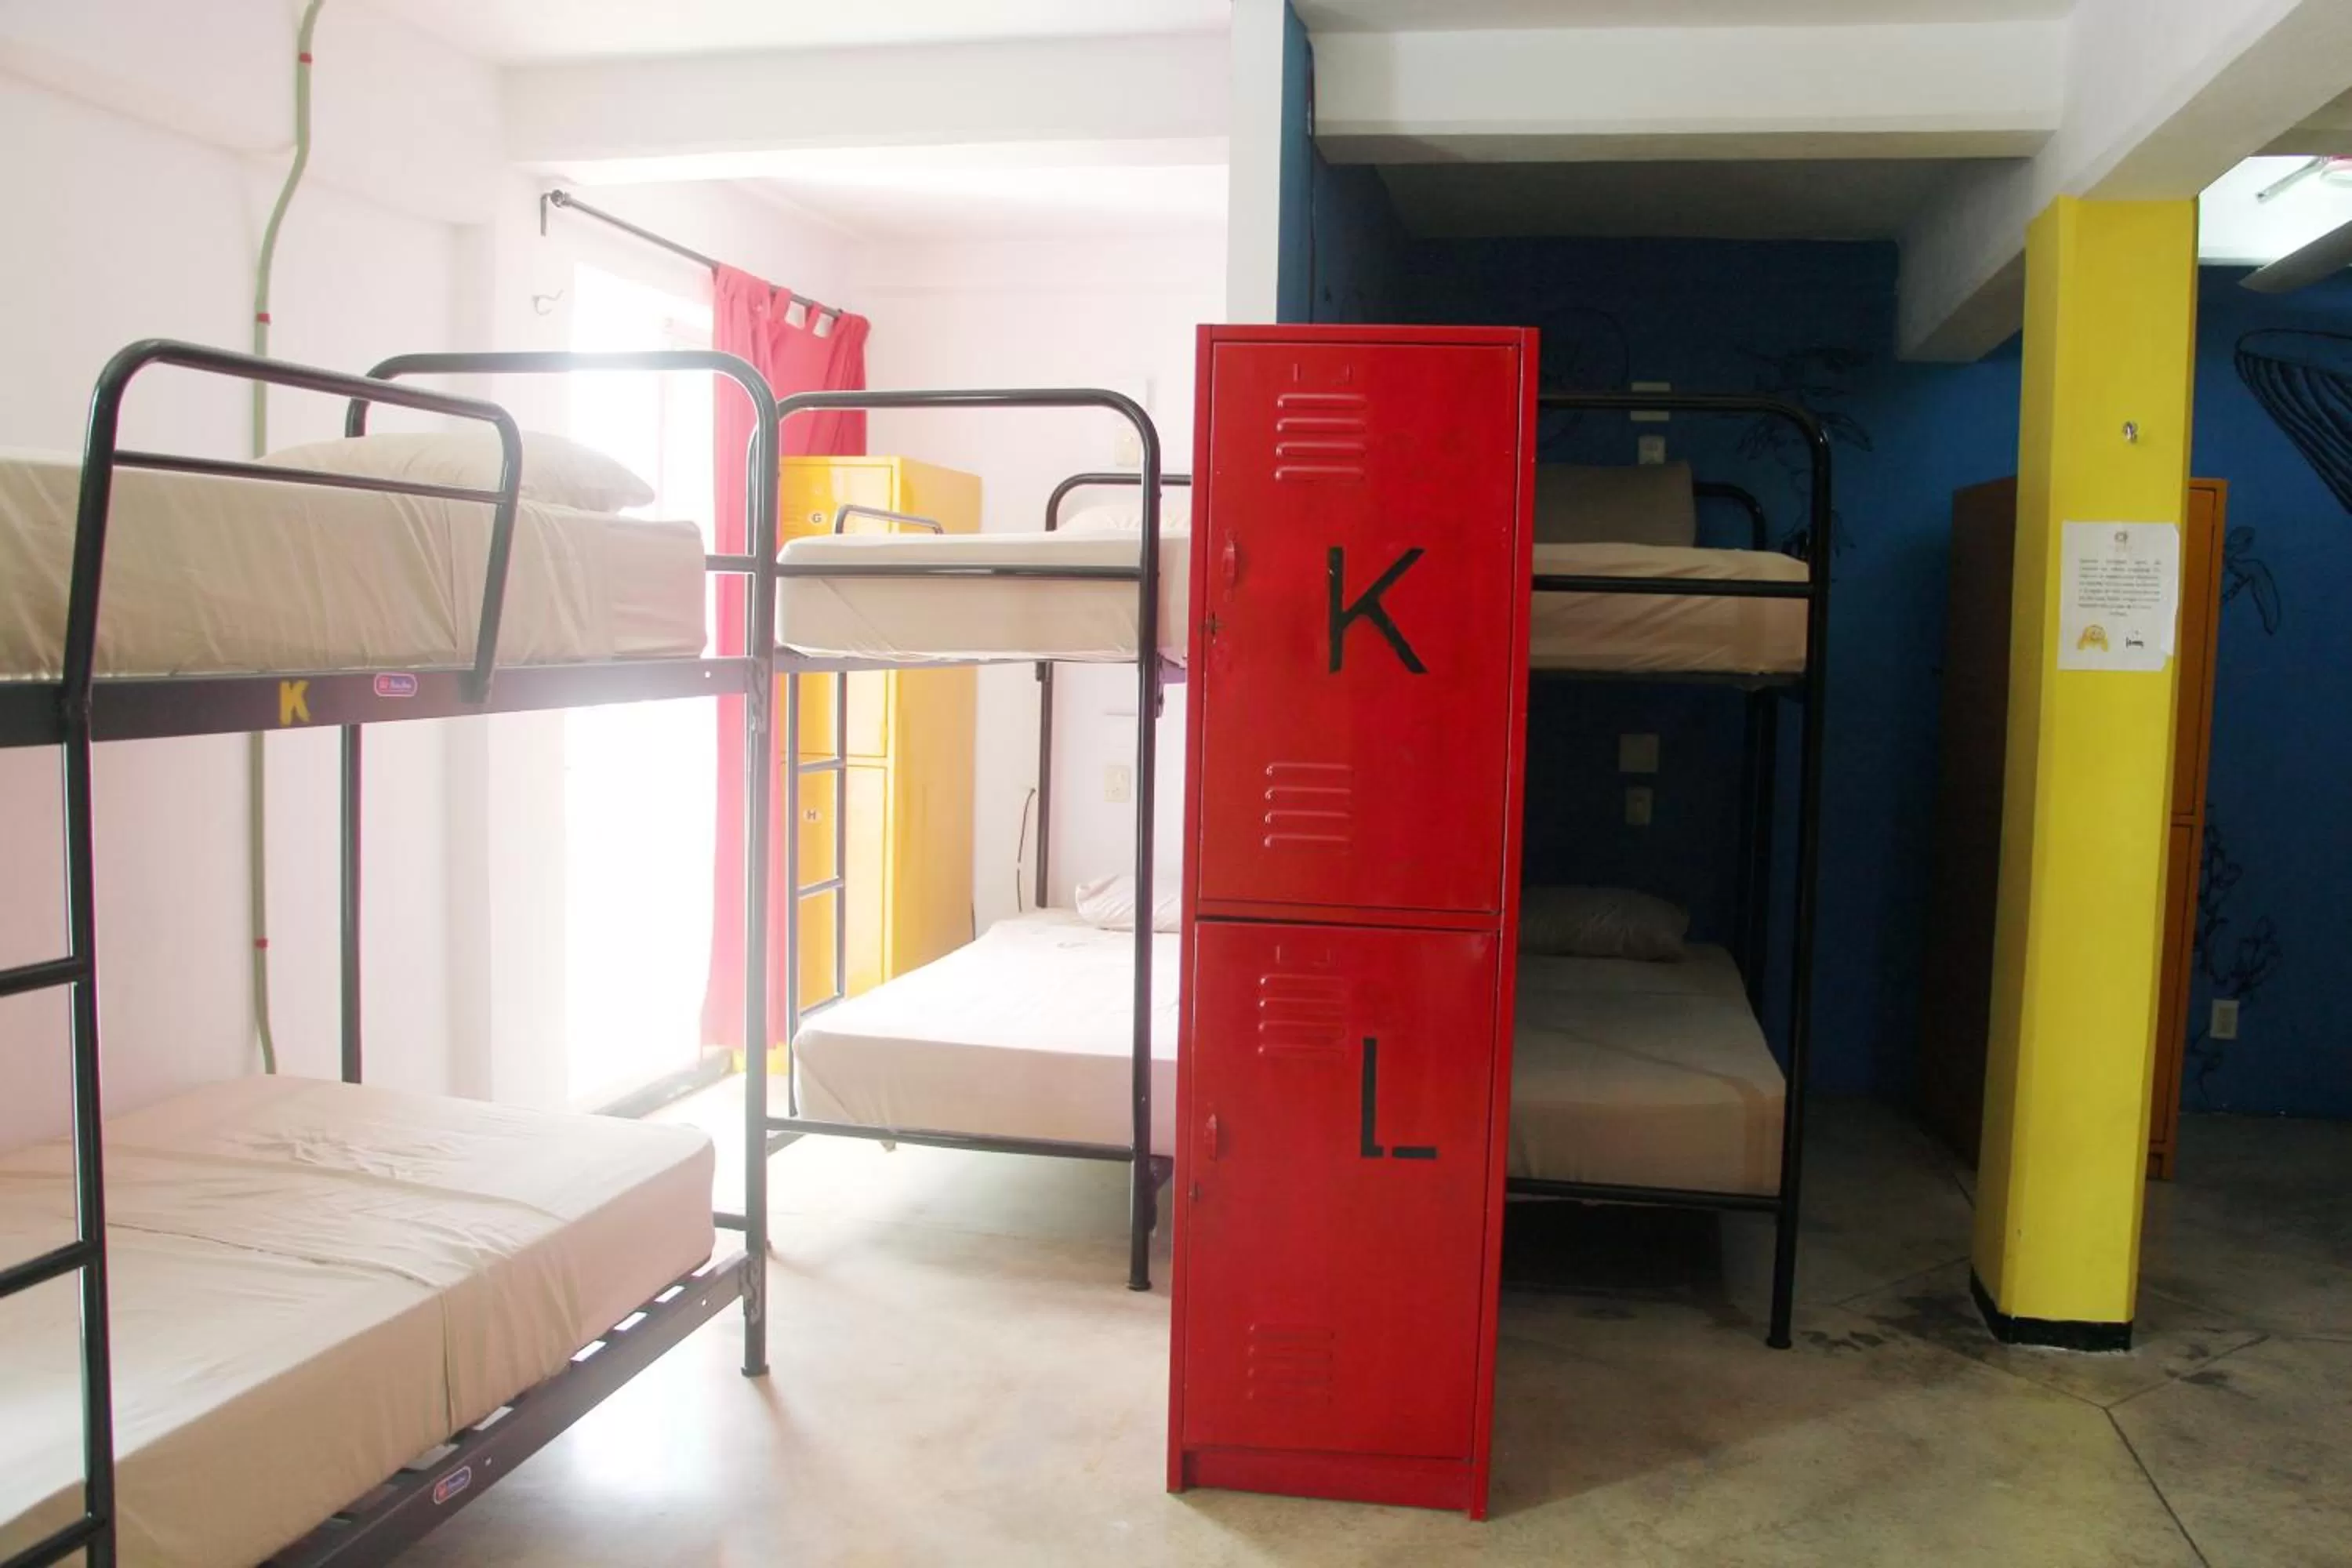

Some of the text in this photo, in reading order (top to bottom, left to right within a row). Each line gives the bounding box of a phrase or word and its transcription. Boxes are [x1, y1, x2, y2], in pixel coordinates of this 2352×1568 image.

[811, 513, 822, 523] G
[1327, 546, 1428, 674] K
[279, 680, 311, 728] K
[807, 810, 816, 820] H
[1360, 1037, 1437, 1159] L
